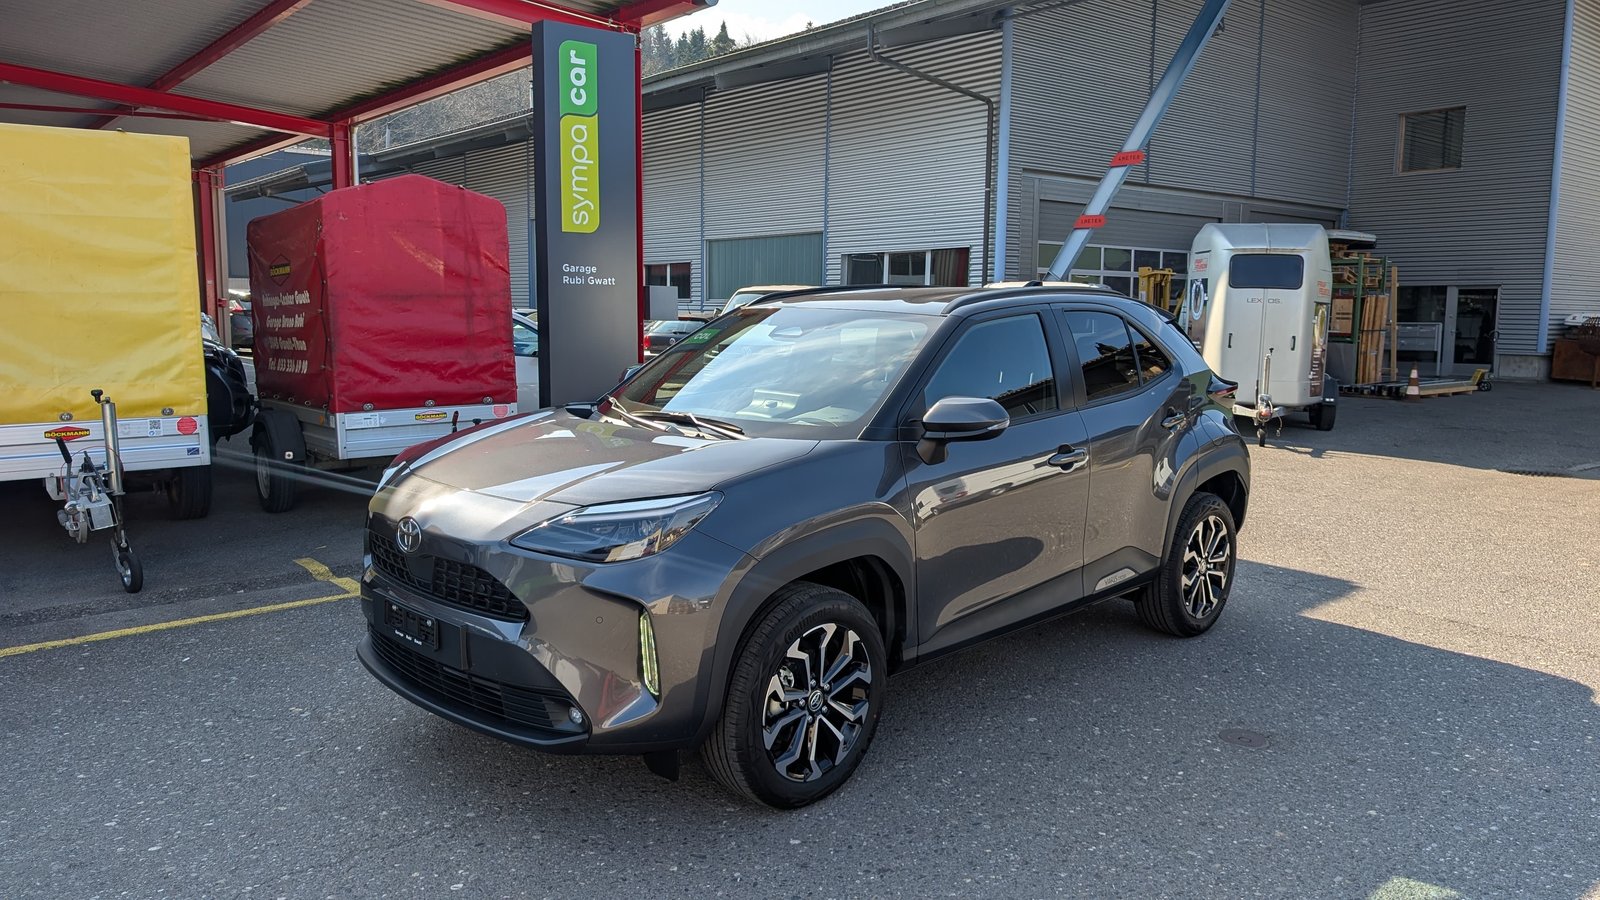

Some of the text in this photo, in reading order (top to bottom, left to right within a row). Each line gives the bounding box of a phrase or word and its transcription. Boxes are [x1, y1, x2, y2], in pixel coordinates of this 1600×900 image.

[569, 49, 587, 106] car
[570, 124, 594, 225] sympa
[562, 263, 597, 275] Garage
[562, 275, 616, 286] Rubi Gwatt
[45, 430, 90, 438] BÖCKMANN
